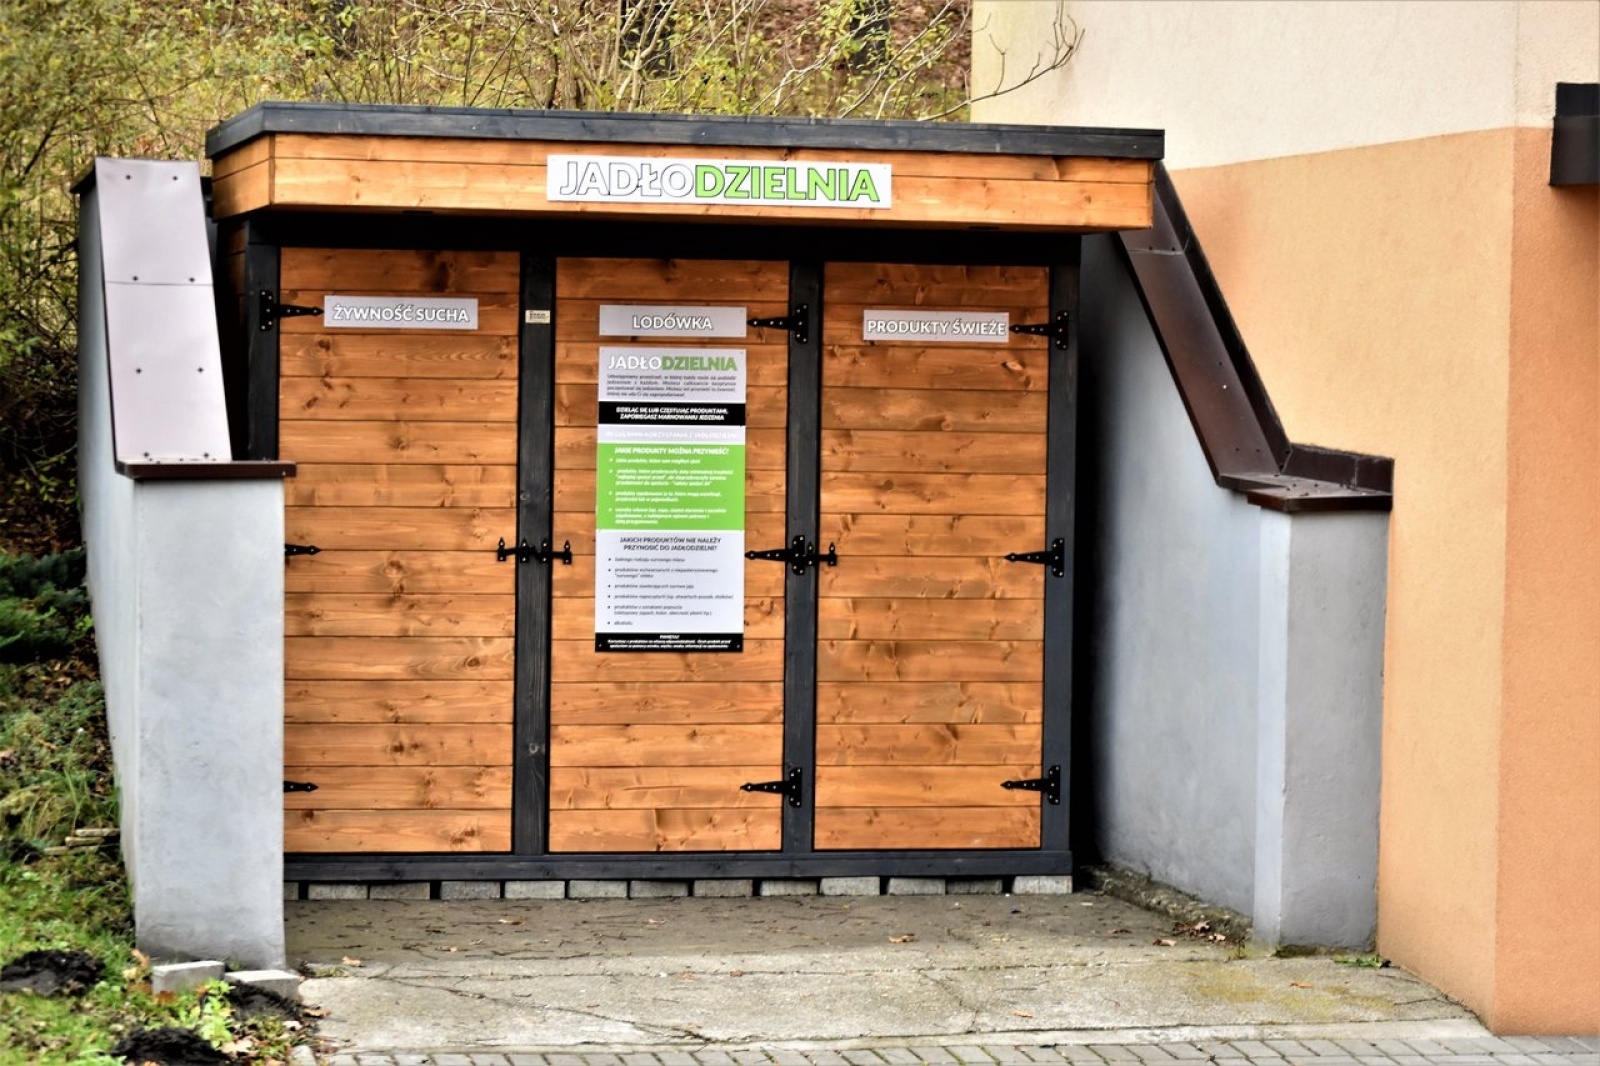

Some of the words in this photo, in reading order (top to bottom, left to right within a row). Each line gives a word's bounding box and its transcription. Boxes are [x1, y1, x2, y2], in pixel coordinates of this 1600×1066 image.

[559, 161, 880, 201] JADŁODZIELNIA
[332, 304, 413, 322] ŻYWNOŚĆ
[416, 307, 470, 322] SUCHA
[632, 312, 714, 330] LODÓWKA
[867, 319, 950, 336] PRODUKTY
[952, 318, 1007, 336] ŚWIEŻE
[608, 355, 737, 371] JADŁODZIELNIA
